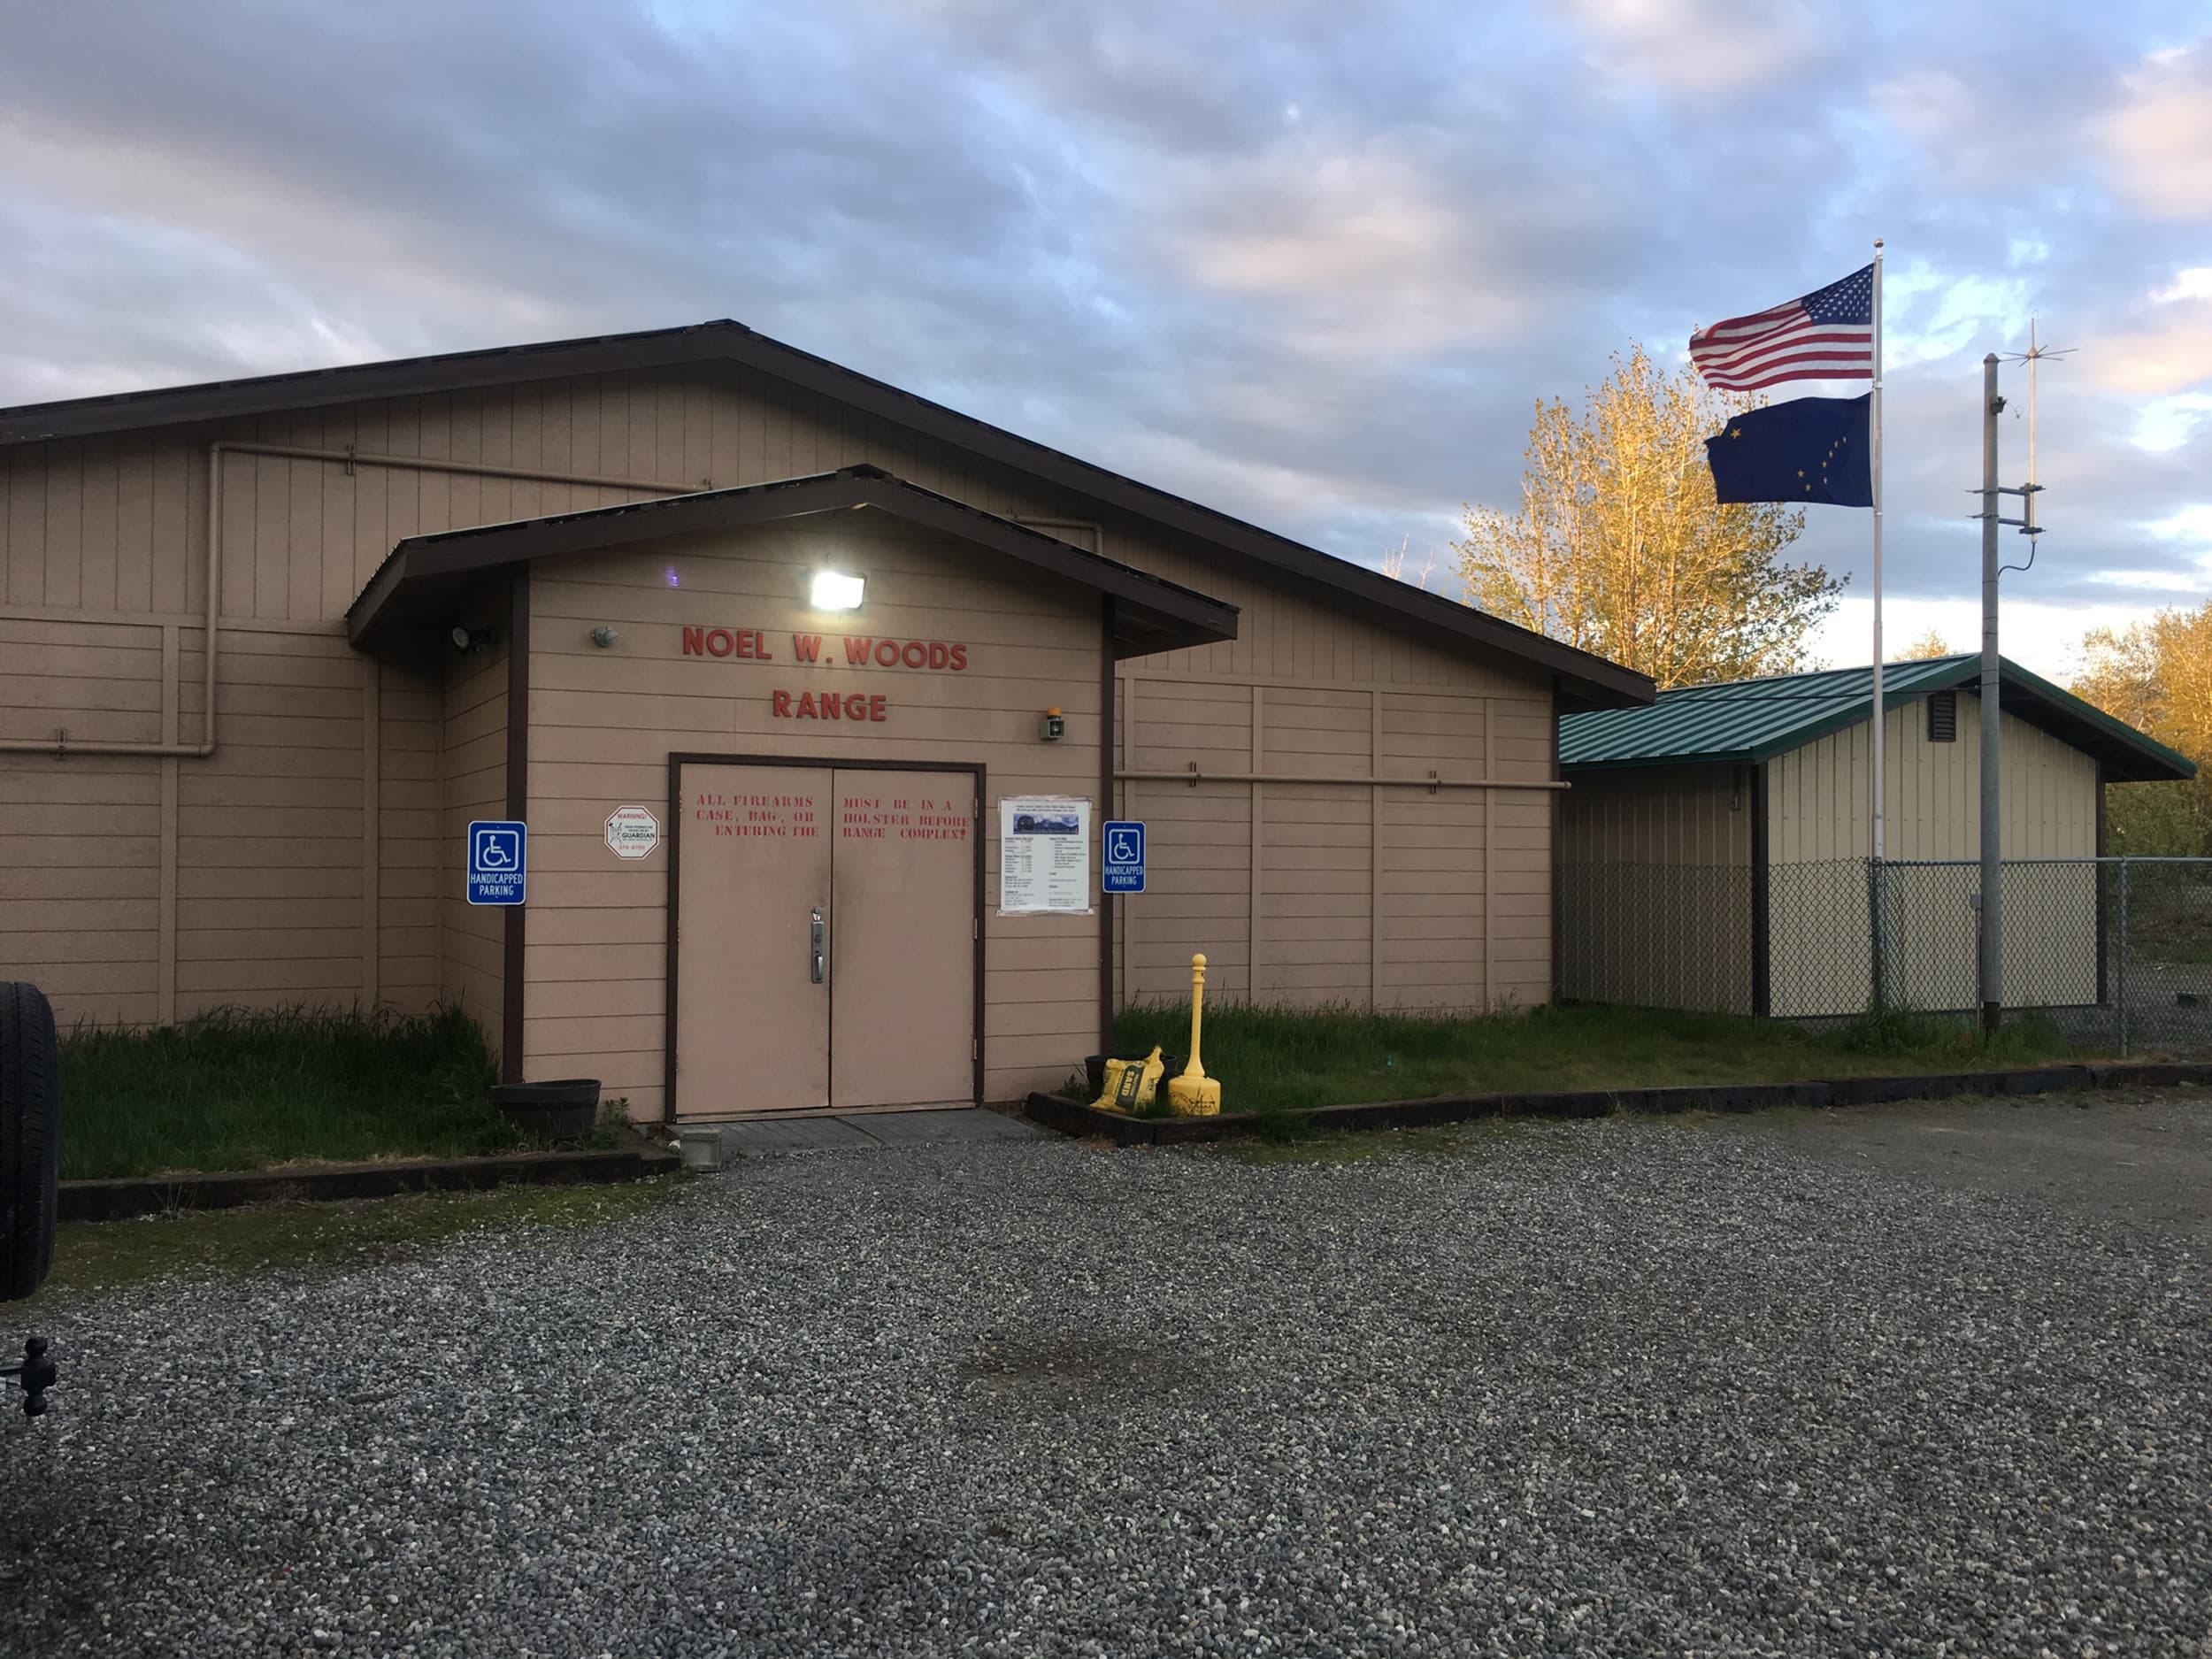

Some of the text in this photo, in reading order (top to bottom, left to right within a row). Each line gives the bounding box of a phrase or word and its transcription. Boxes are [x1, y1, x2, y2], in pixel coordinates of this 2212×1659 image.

[682, 626, 968, 671] NOEL W. WOODS
[772, 689, 887, 721] RANGE
[696, 795, 952, 810] ALL FIREARMS MUST BE IN A
[794, 811, 814, 822] OR
[843, 813, 910, 825] HOLSTER
[919, 815, 970, 827] BEFORE
[715, 825, 967, 840] ENTERING THE RANGE COMPLEX!
[1105, 865, 1144, 875] HANDICAPPED
[470, 873, 524, 884] HANDICAPPED
[1111, 875, 1138, 885] PARKING
[479, 885, 514, 895] PARKING
[1121, 1070, 1135, 1096] SAND
